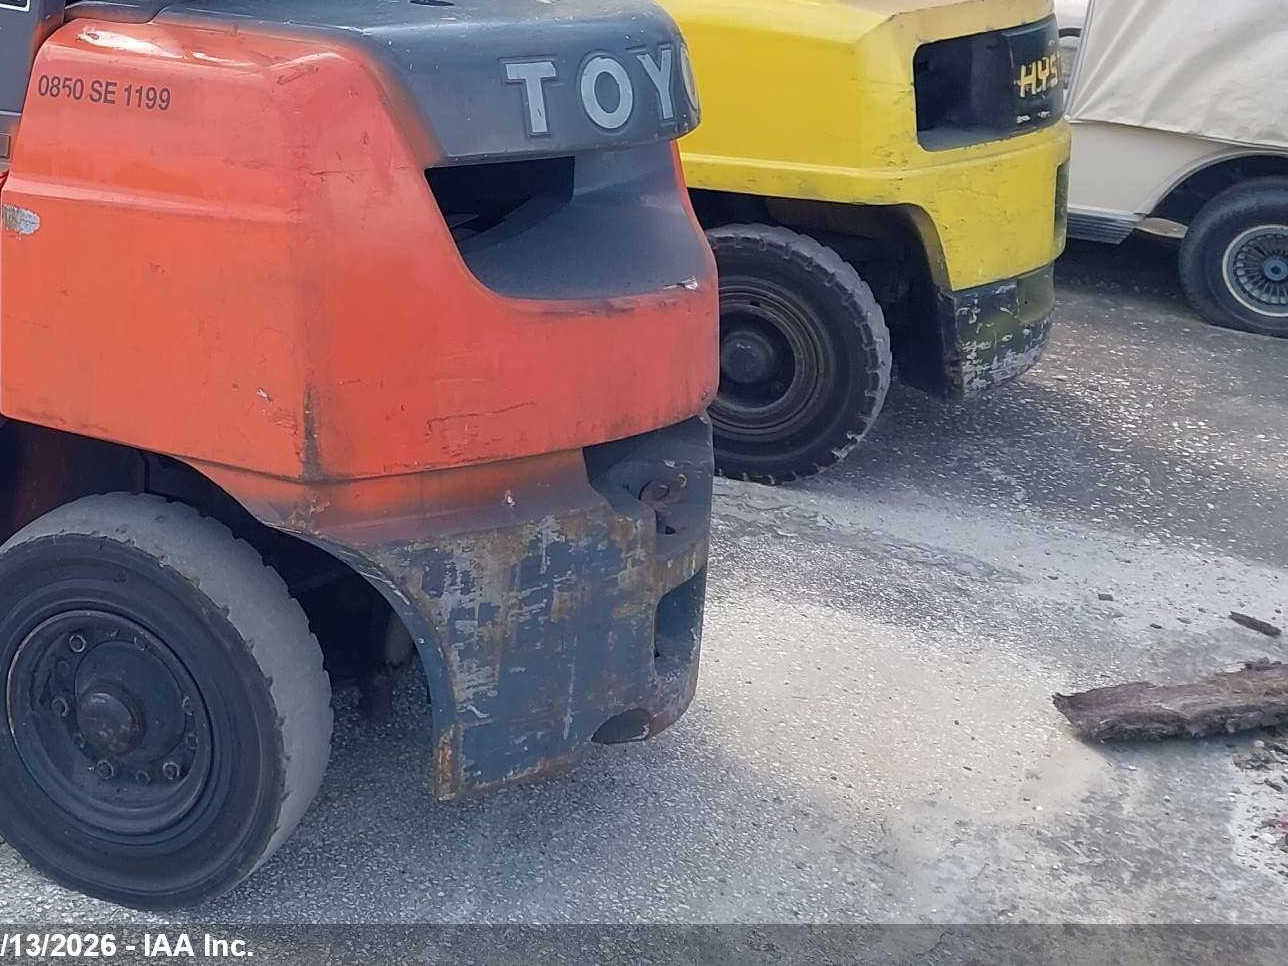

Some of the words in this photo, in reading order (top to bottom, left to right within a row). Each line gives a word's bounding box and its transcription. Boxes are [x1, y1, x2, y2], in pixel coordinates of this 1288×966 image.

[38, 74, 84, 101] 0850
[89, 79, 118, 105] SE
[124, 83, 171, 111] 1199
